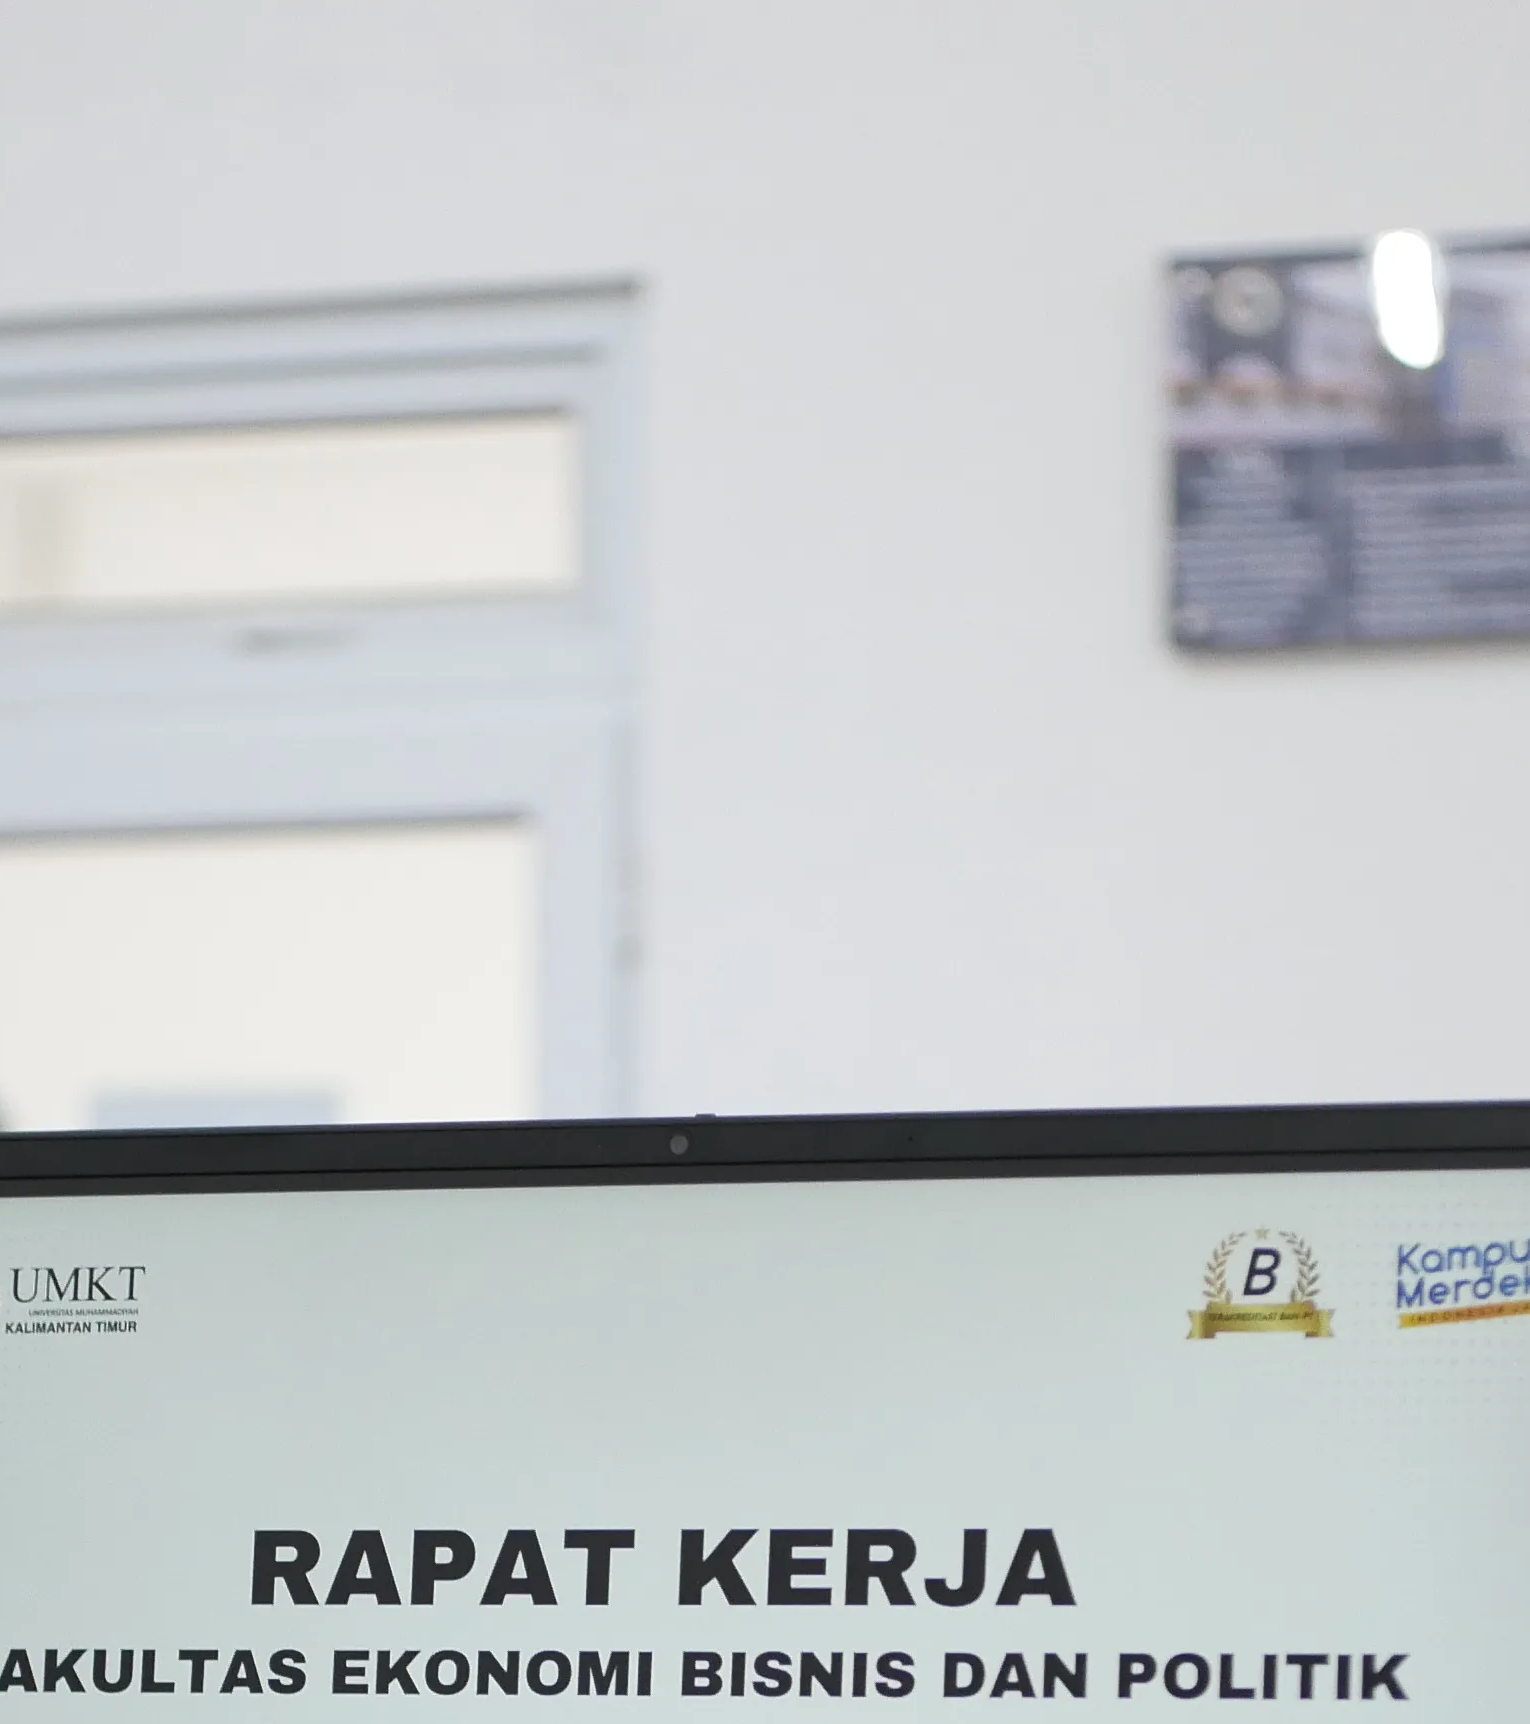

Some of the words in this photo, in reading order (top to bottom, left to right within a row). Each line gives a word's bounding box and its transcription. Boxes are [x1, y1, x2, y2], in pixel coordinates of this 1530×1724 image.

[11, 1265, 147, 1304] UMKT
[1243, 1247, 1281, 1296] B
[5, 1321, 91, 1335] KALIMANTAN
[95, 1320, 137, 1333] TIMUR
[251, 1528, 636, 1606] RAPAT
[678, 1528, 1077, 1608] KERJA
[332, 1649, 653, 1697] EKONOMI
[681, 1651, 915, 1698] BISNIS
[943, 1652, 1088, 1699] DAN
[1117, 1652, 1408, 1700] POLITIK
